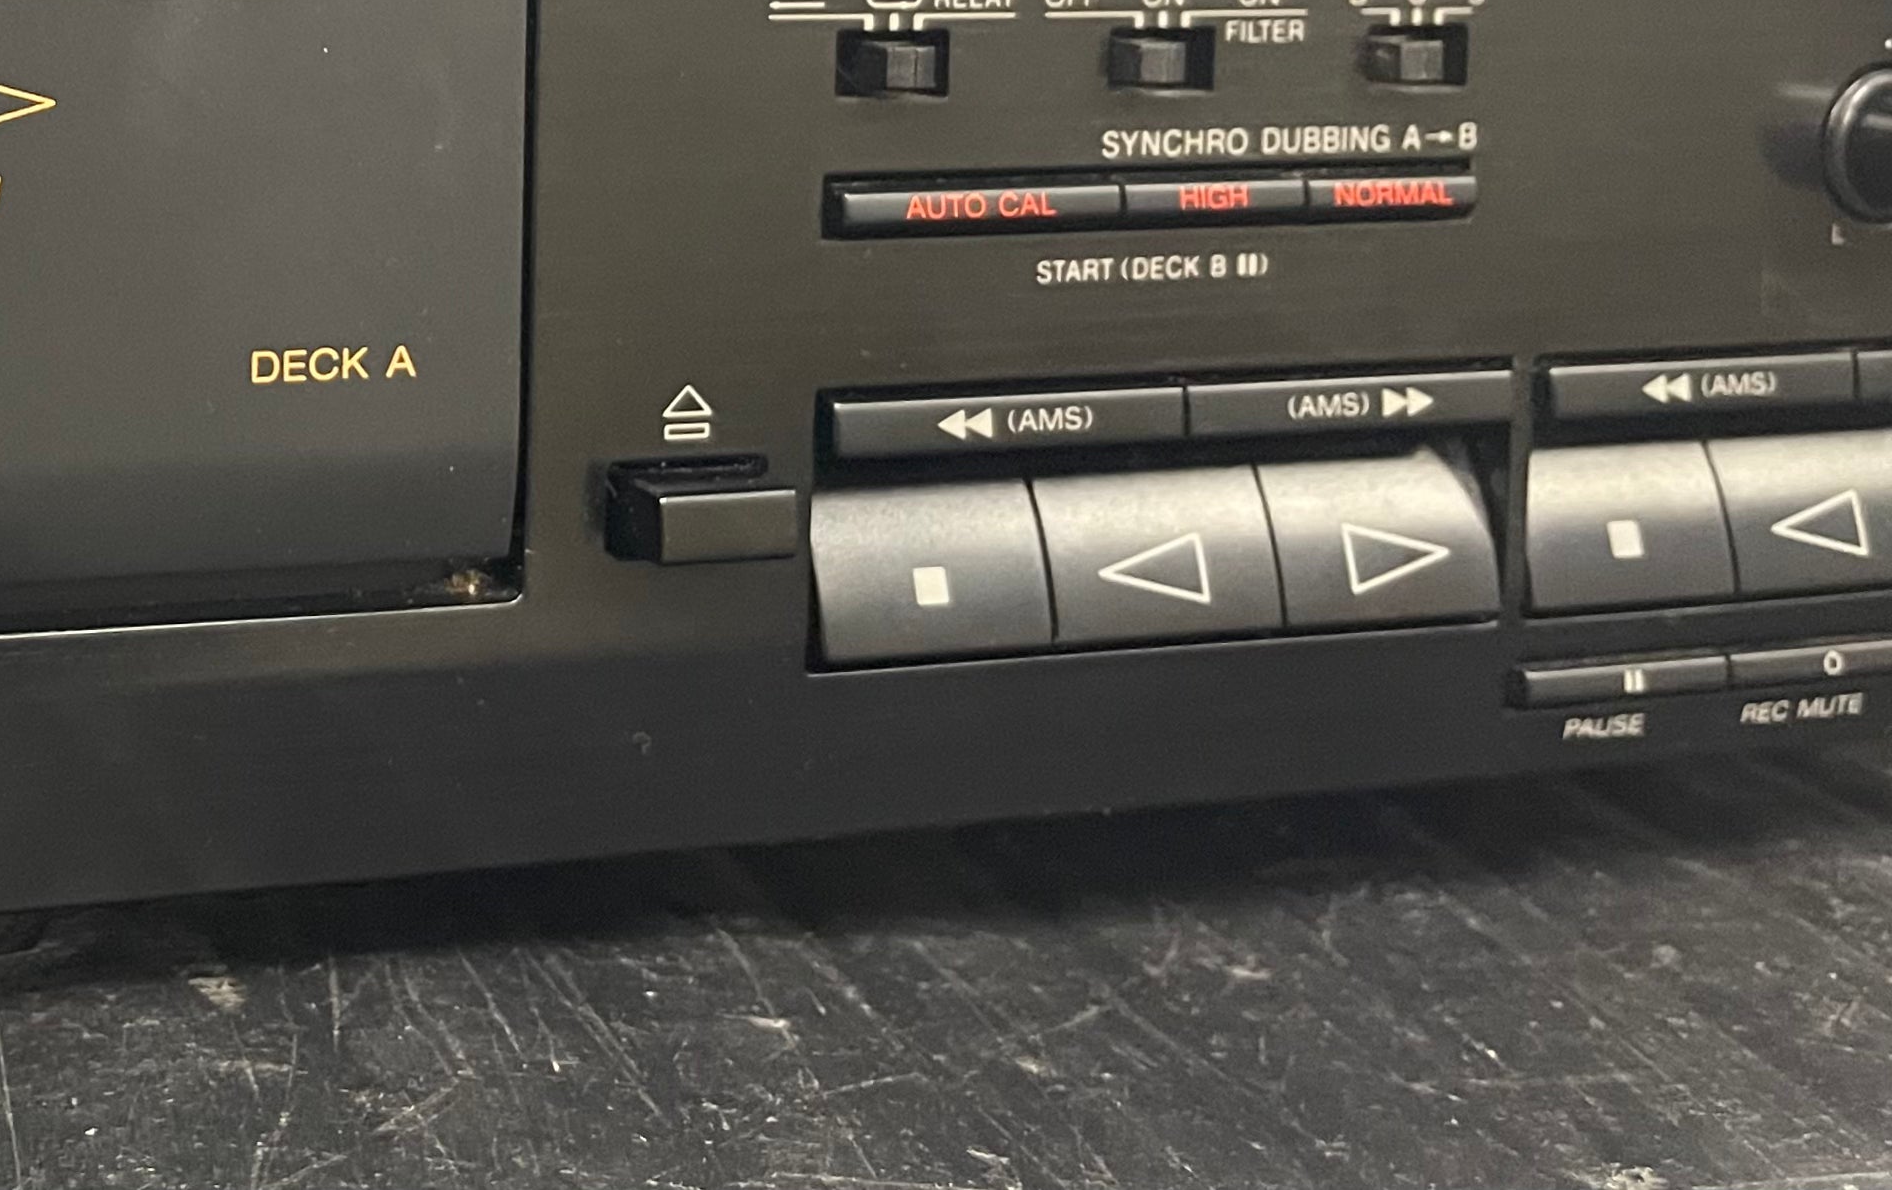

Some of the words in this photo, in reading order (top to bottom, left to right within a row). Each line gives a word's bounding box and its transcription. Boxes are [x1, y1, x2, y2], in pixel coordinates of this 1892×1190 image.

[1225, 19, 1305, 43] FILTER
[1101, 128, 1249, 159] SYNCHRO
[1261, 125, 1390, 155] DUBBING
[905, 194, 987, 221] AUTO
[998, 191, 1058, 217] CAL
[1179, 184, 1249, 210] HIGH
[1333, 181, 1454, 206] NORMAL
[1831, 222, 1845, 246] L
[1036, 258, 1114, 284] START
[1121, 256, 1200, 282] (DECK
[250, 346, 370, 384] DECK
[385, 344, 417, 379] A
[1701, 371, 1778, 399] (AMS)
[1007, 405, 1094, 434] (AMS)
[1286, 392, 1371, 419] (AMS)
[1740, 699, 1789, 725] REC
[1796, 692, 1865, 719] MUTE
[1562, 713, 1646, 741] PAUSE
